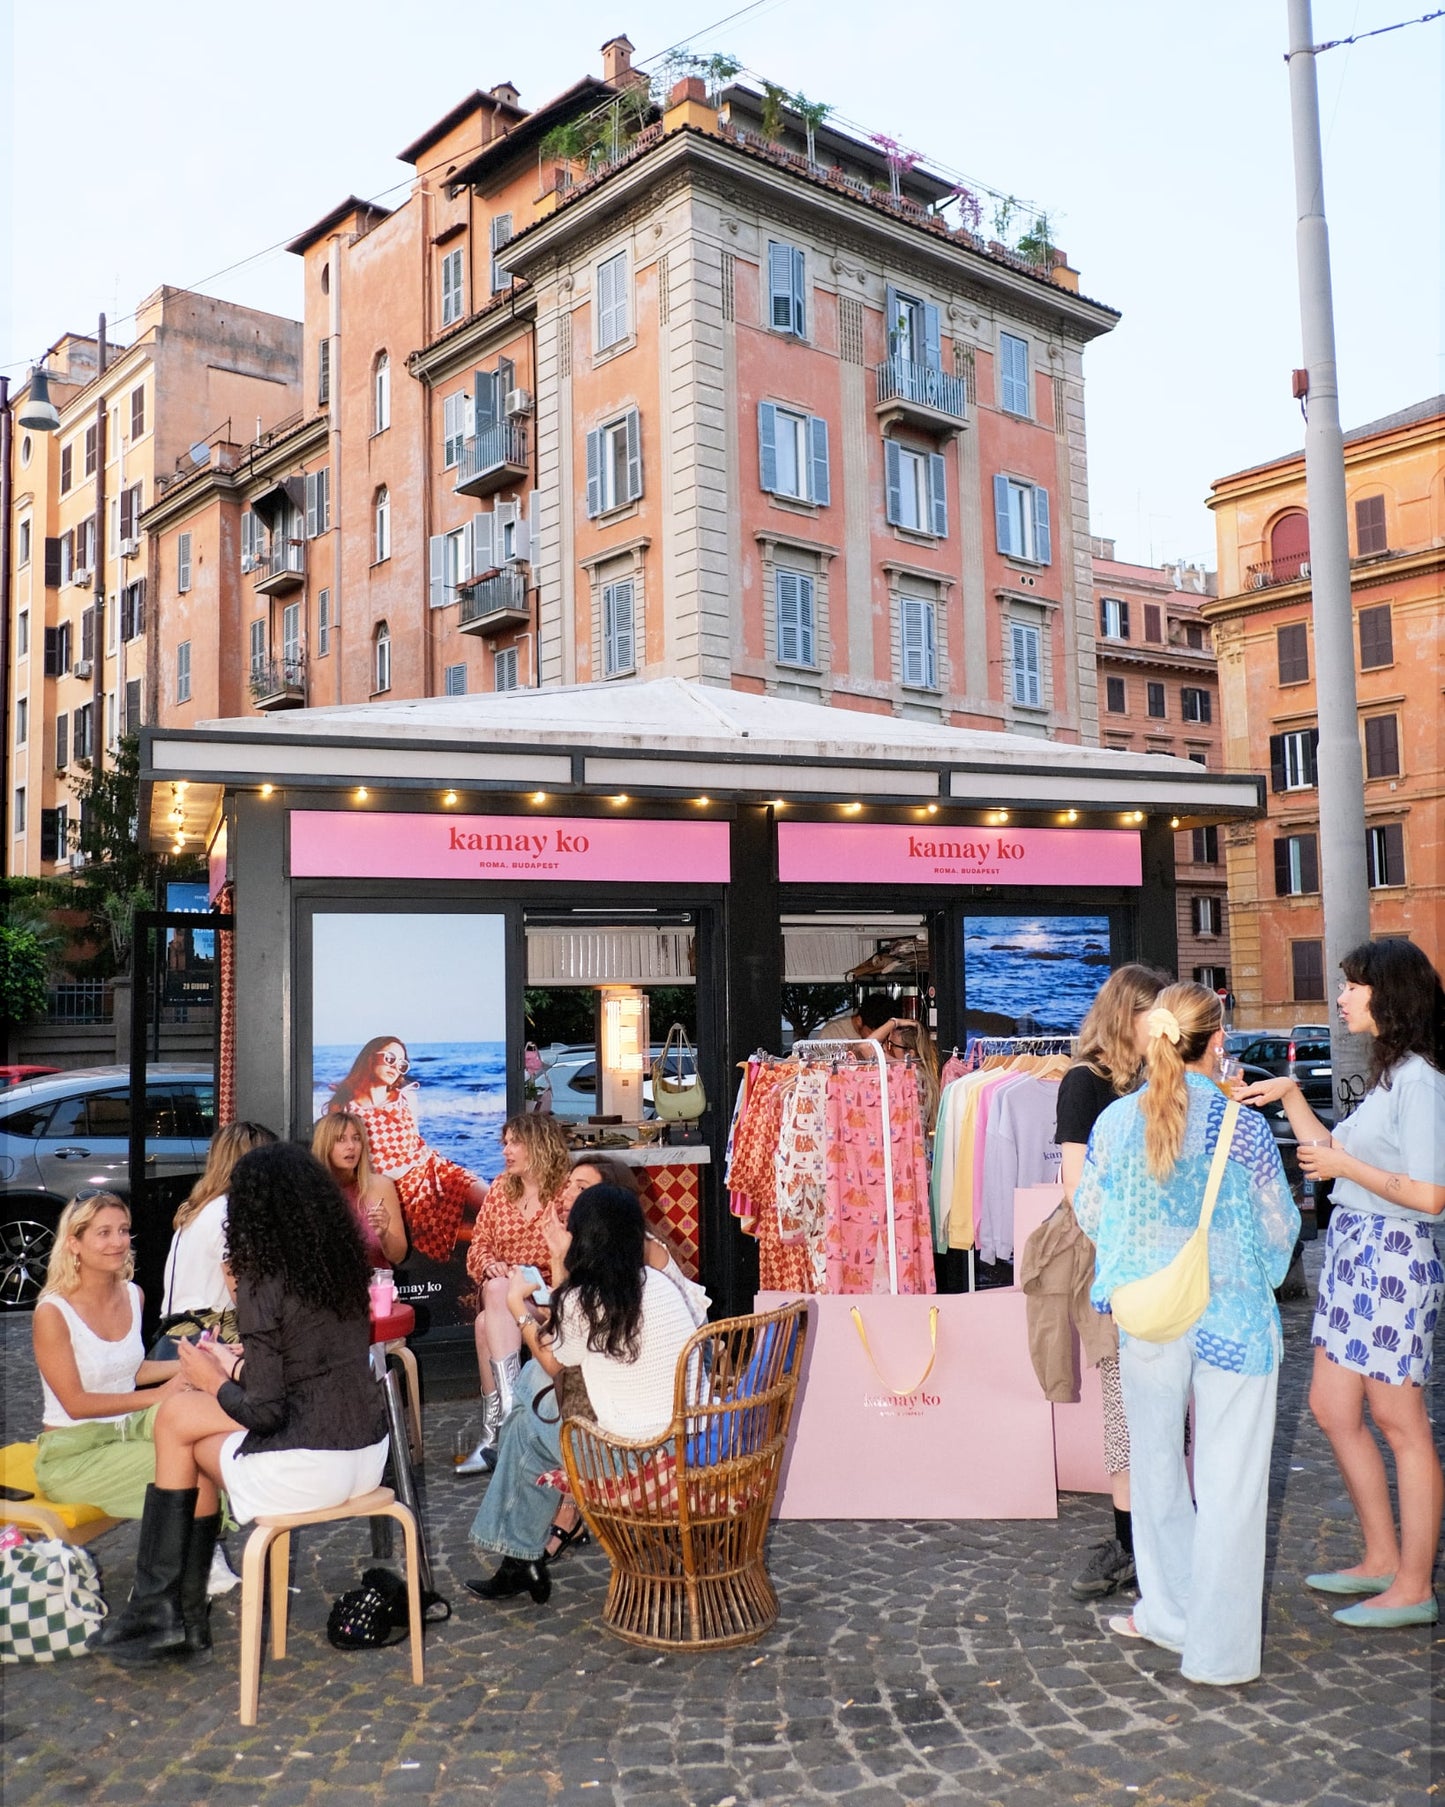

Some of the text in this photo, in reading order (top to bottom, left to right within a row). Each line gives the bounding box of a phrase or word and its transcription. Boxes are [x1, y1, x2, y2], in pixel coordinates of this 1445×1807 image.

[449, 827, 589, 859] kamay ko
[908, 836, 1025, 865] kamay ko
[399, 1281, 442, 1295] may ko
[921, 1392, 941, 1406] ko
